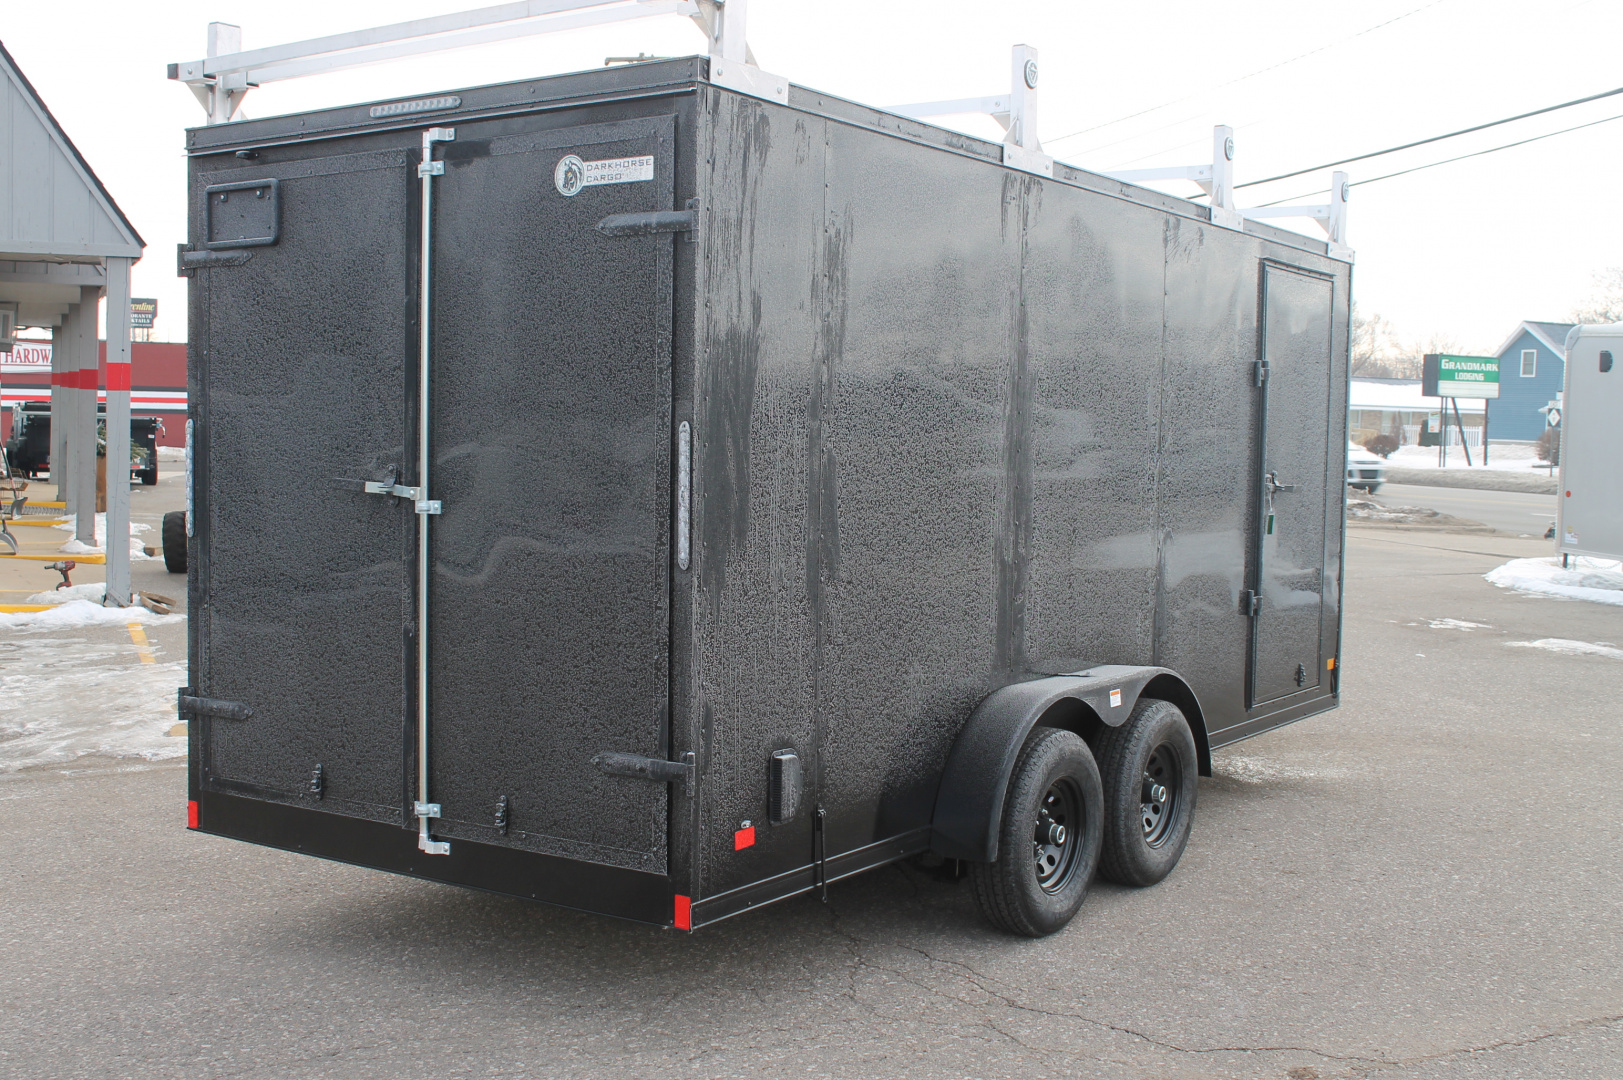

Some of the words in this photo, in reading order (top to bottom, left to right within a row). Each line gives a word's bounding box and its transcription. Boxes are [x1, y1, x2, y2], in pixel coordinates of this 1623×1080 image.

[586, 158, 652, 171] DARKHORSE
[586, 173, 622, 183] CARGO
[5, 348, 52, 364] HARDW
[1441, 359, 1499, 372] GRANDMARK
[1455, 371, 1485, 381] LODGING
